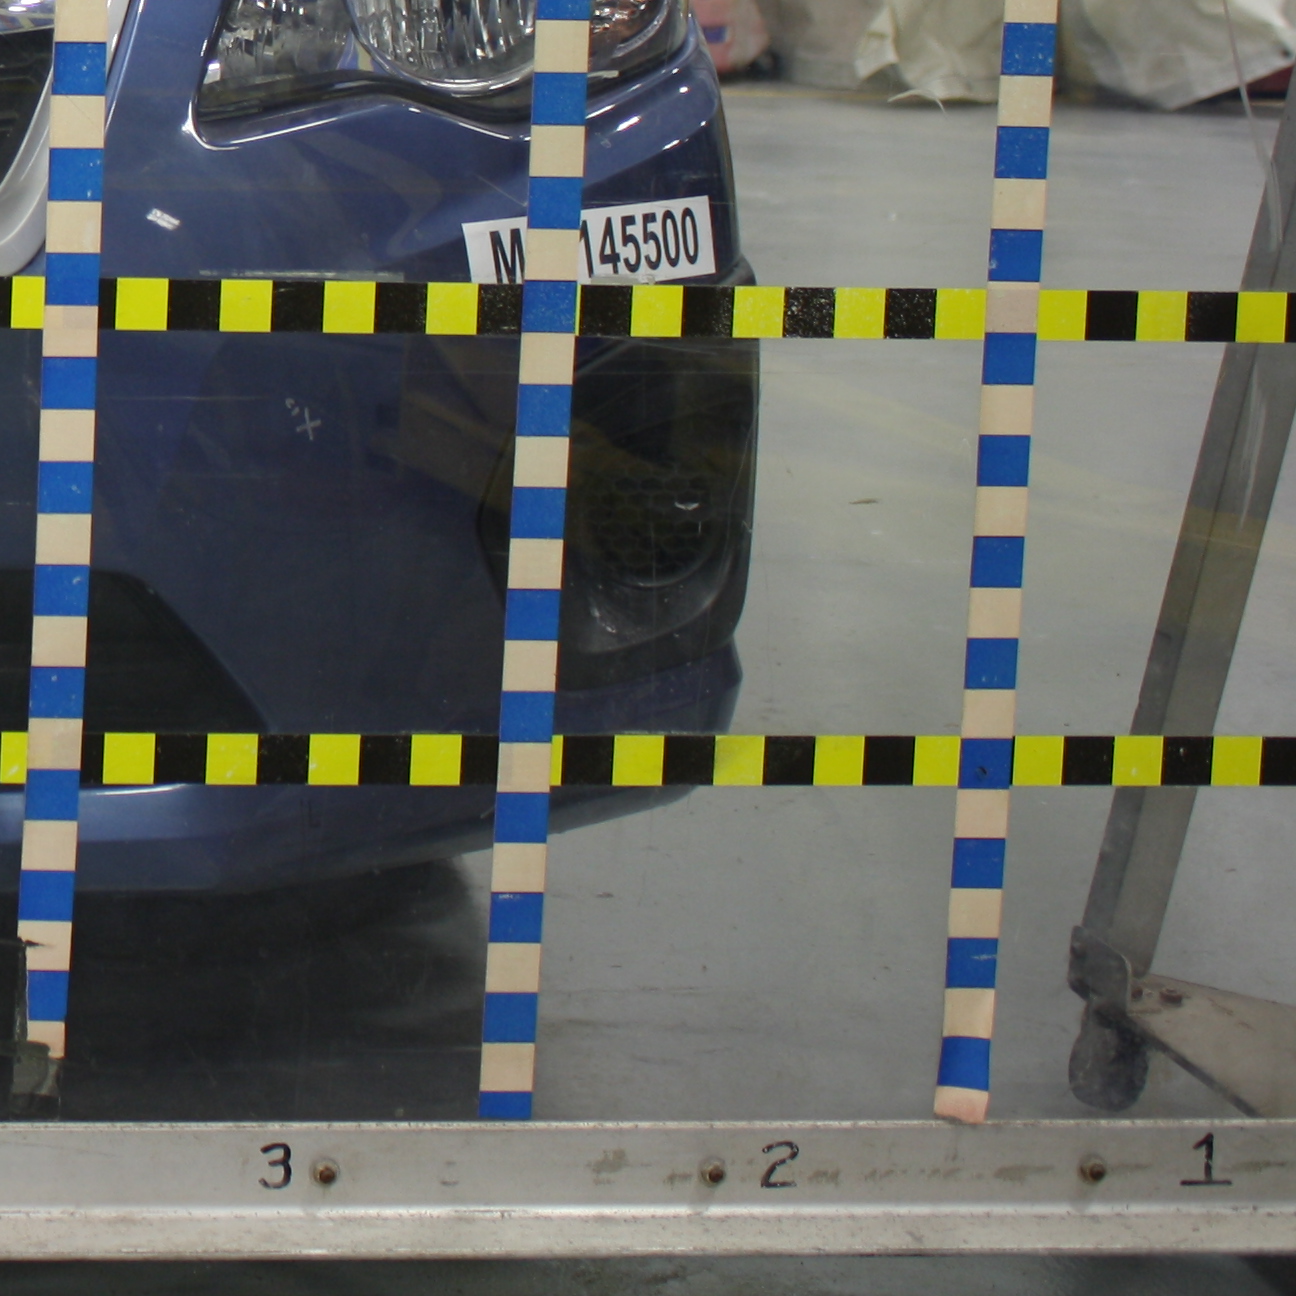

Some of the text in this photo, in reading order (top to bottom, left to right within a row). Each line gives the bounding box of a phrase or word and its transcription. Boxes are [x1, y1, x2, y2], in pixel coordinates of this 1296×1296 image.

[488, 206, 700, 285] M145500
[258, 1142, 293, 1190] 3
[760, 1140, 800, 1189] 2
[1180, 1132, 1232, 1187] 1
